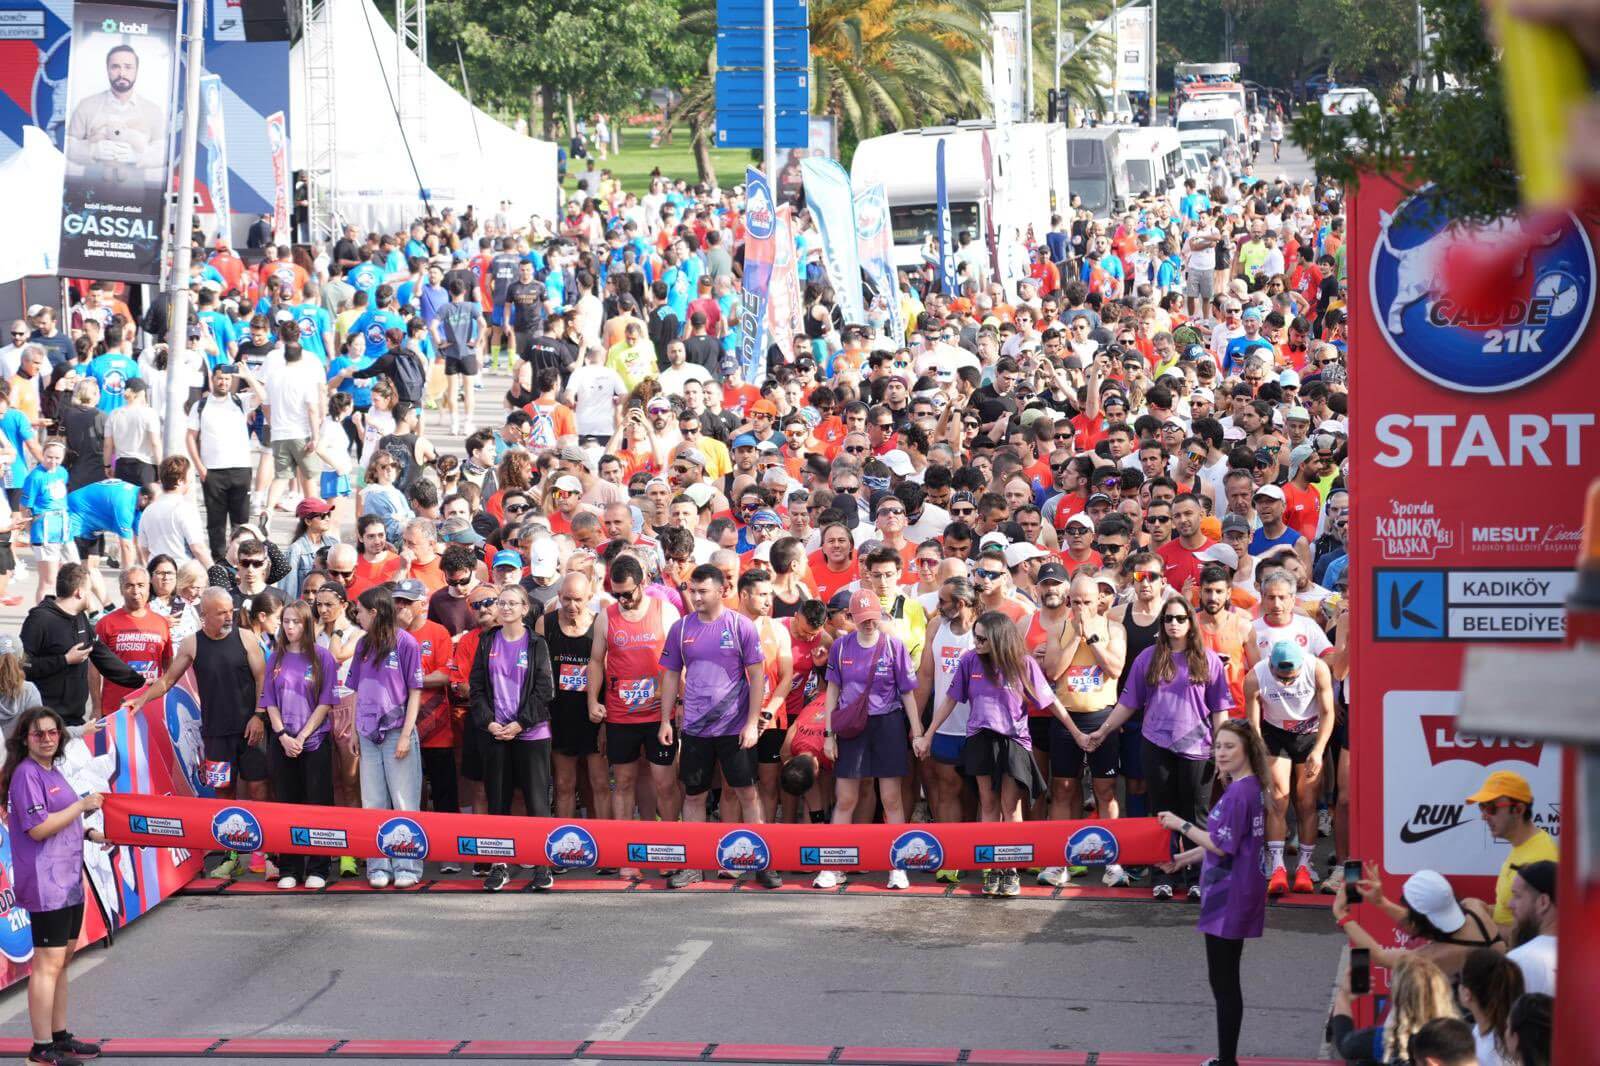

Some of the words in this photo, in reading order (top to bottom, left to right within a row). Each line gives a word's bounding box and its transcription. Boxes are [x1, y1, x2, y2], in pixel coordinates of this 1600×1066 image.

[64, 213, 158, 240] GASSAL
[1481, 329, 1545, 353] 21K
[1373, 413, 1595, 468] START
[1375, 516, 1441, 539] KADIKÖY
[1472, 527, 1540, 542] MESUT
[1388, 538, 1430, 557] BAŞKA
[1463, 577, 1550, 597] KADIKÖY
[624, 690, 650, 699] 3718
[1412, 804, 1464, 826] RUN
